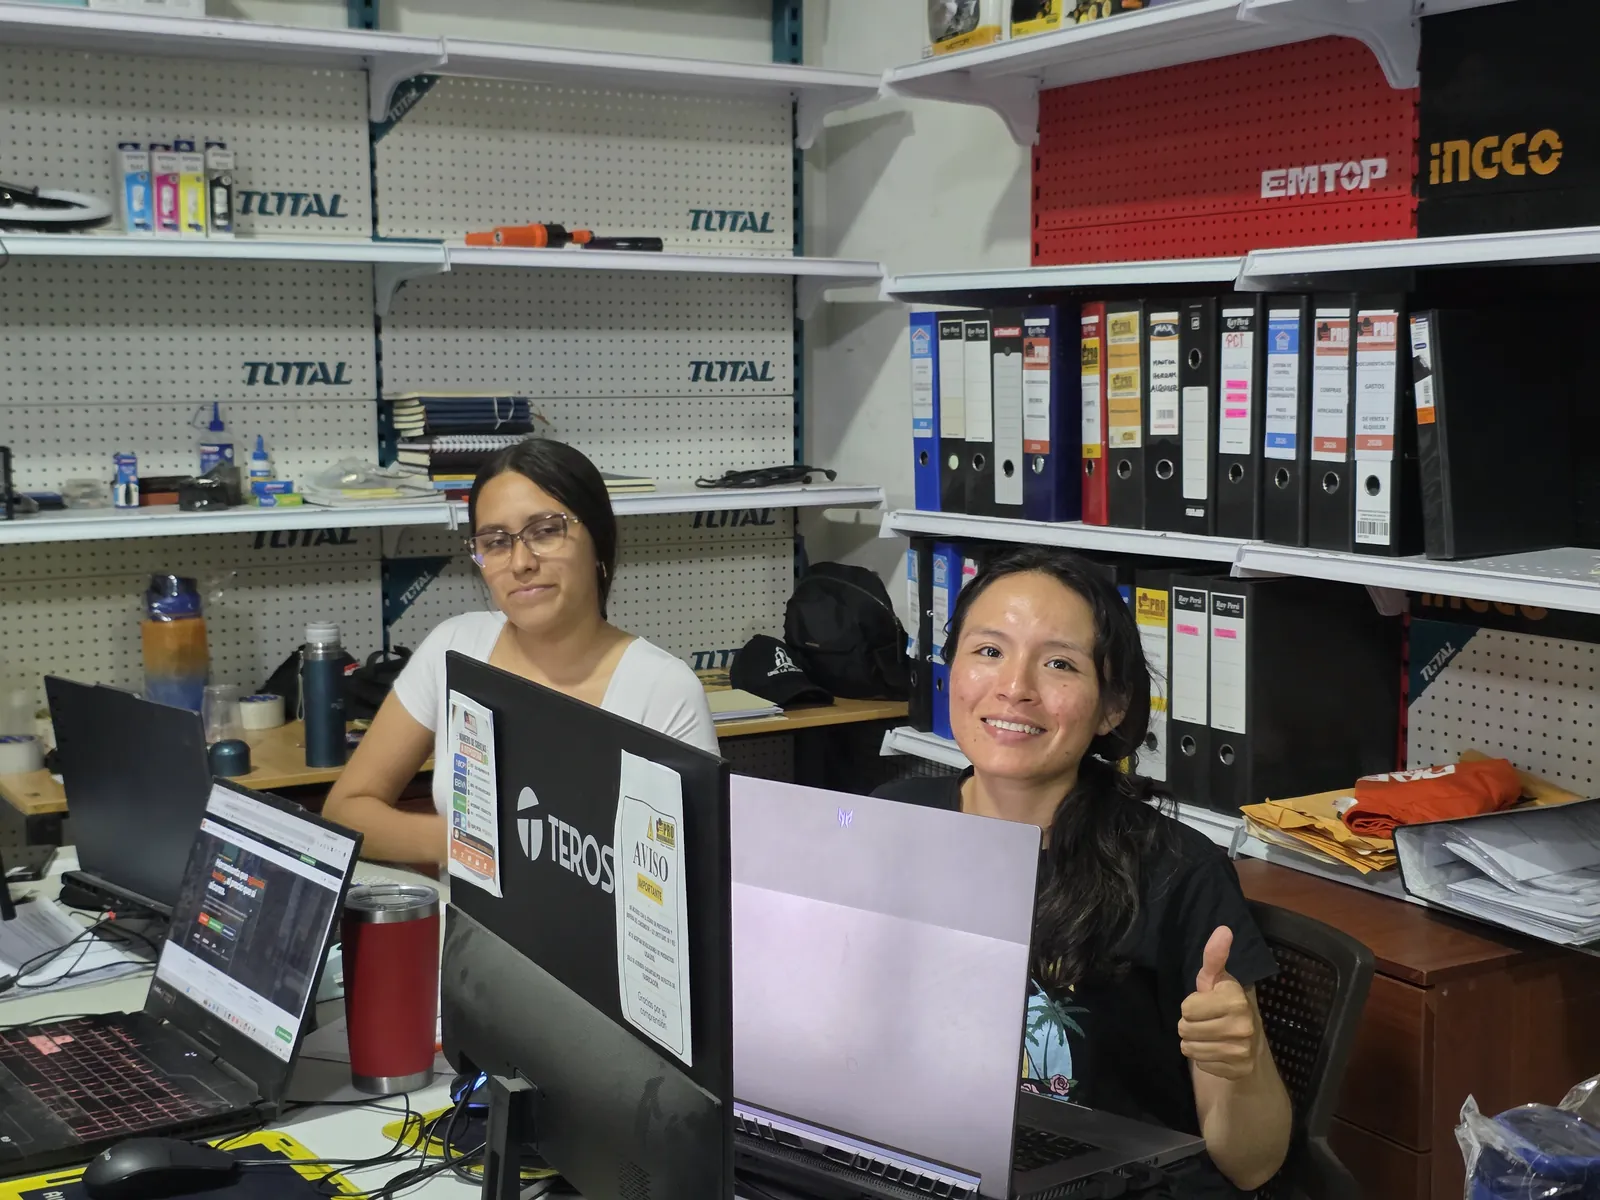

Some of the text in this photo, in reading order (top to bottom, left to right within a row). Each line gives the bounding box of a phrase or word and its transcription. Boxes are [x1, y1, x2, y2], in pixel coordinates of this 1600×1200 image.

[1261, 158, 1387, 198] EMTOP
[238, 191, 348, 217] TOTAL
[689, 209, 774, 233] TOTAL
[1153, 323, 1176, 336] MAX
[1374, 321, 1395, 337] PRO
[242, 361, 353, 386] TOTAL
[689, 360, 775, 382] TOTAL
[692, 508, 776, 529] TOTAL
[253, 527, 357, 550] TOTAL
[400, 571, 432, 605] TOTAL
[1150, 598, 1166, 612] PRO
[1420, 641, 1456, 681] TOTAL
[664, 823, 675, 839] PRO
[548, 813, 615, 894] TEROS
[632, 840, 669, 882] AVISO
[638, 877, 663, 901] IMPORTANTE
[637, 991, 654, 1010] Gracias
